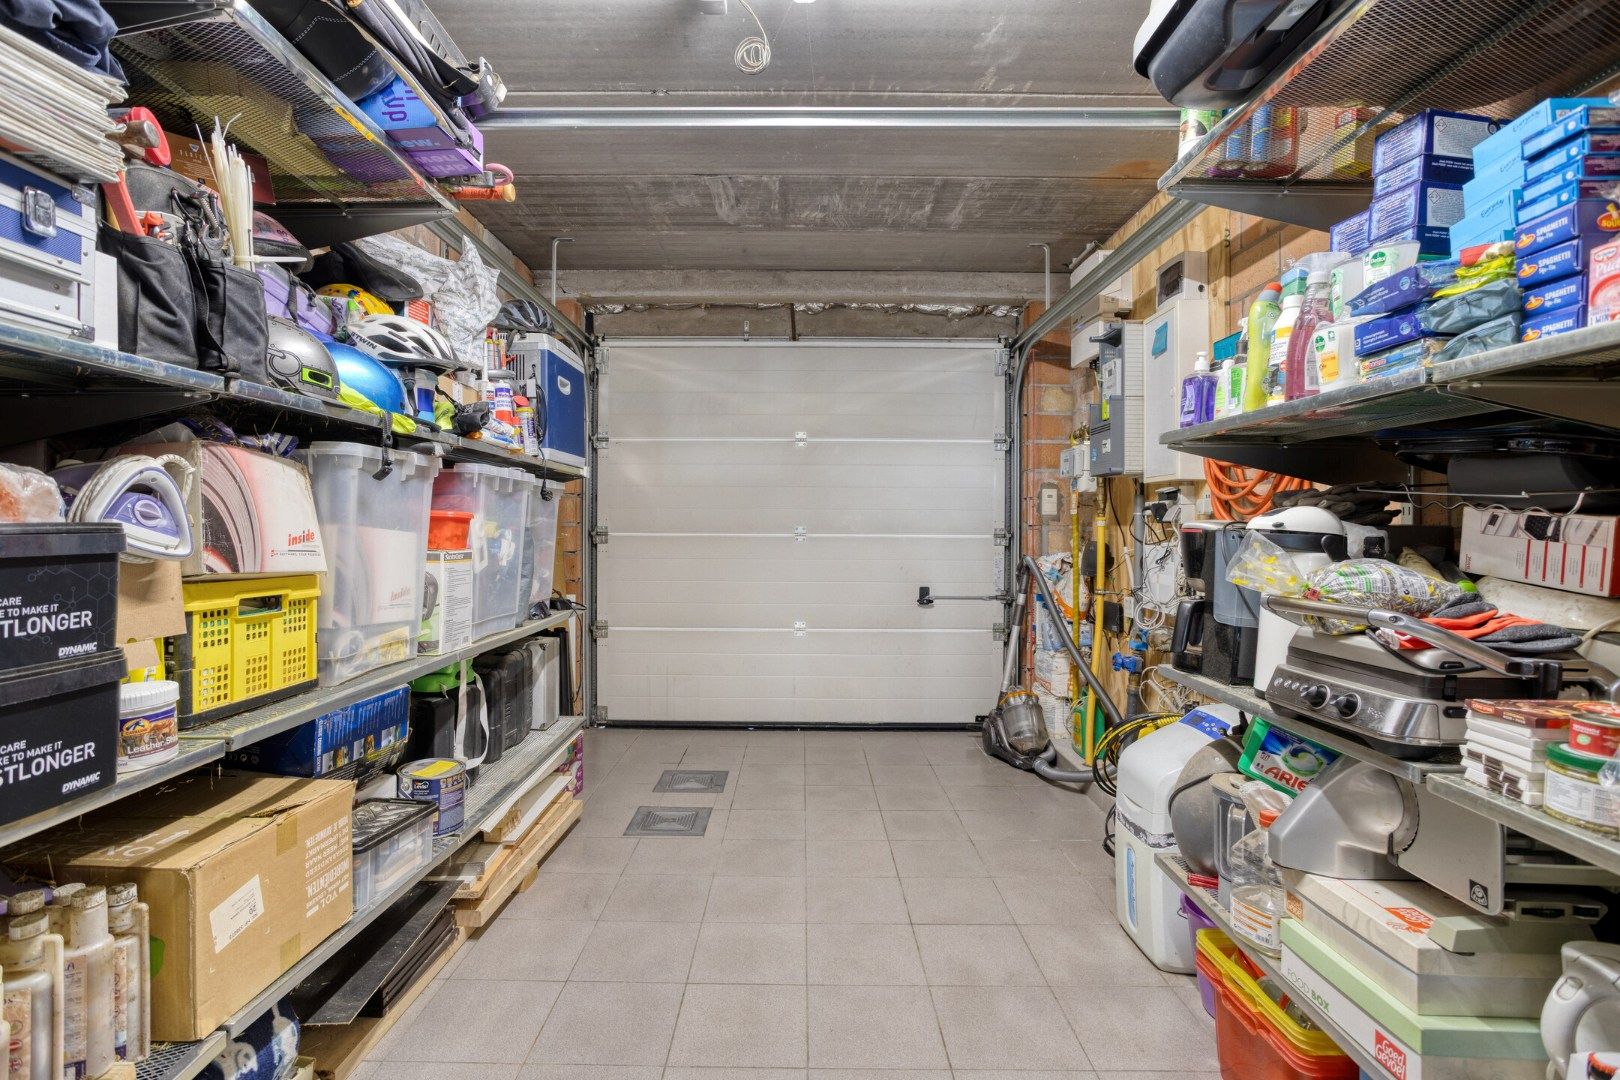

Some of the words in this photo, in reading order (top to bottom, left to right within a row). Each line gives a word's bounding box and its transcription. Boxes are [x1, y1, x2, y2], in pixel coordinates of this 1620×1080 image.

[1536, 216, 1569, 236] SPAGHETTI
[1538, 250, 1571, 268] SPAGHETTI
[1544, 284, 1576, 301] SPAGHETTI
[1541, 318, 1574, 334] SPAGHETTI
[287, 529, 315, 547] inside
[7, 608, 20, 618] TO
[22, 605, 49, 616] MAKE
[50, 603, 60, 613] IT
[58, 641, 98, 657] DYNAMIC
[0, 740, 27, 755] CARE
[12, 752, 25, 763] TO
[26, 744, 53, 758] MAKE
[54, 740, 63, 751] IT
[127, 741, 165, 754] Leather
[61, 771, 101, 793] DYNAMIC
[1264, 766, 1310, 791] ARIE
[1287, 967, 1310, 993] FOOD
[1310, 989, 1330, 1013] BOX
[1375, 1043, 1406, 1080] Gevoel
[1382, 1040, 1405, 1067] Goed
